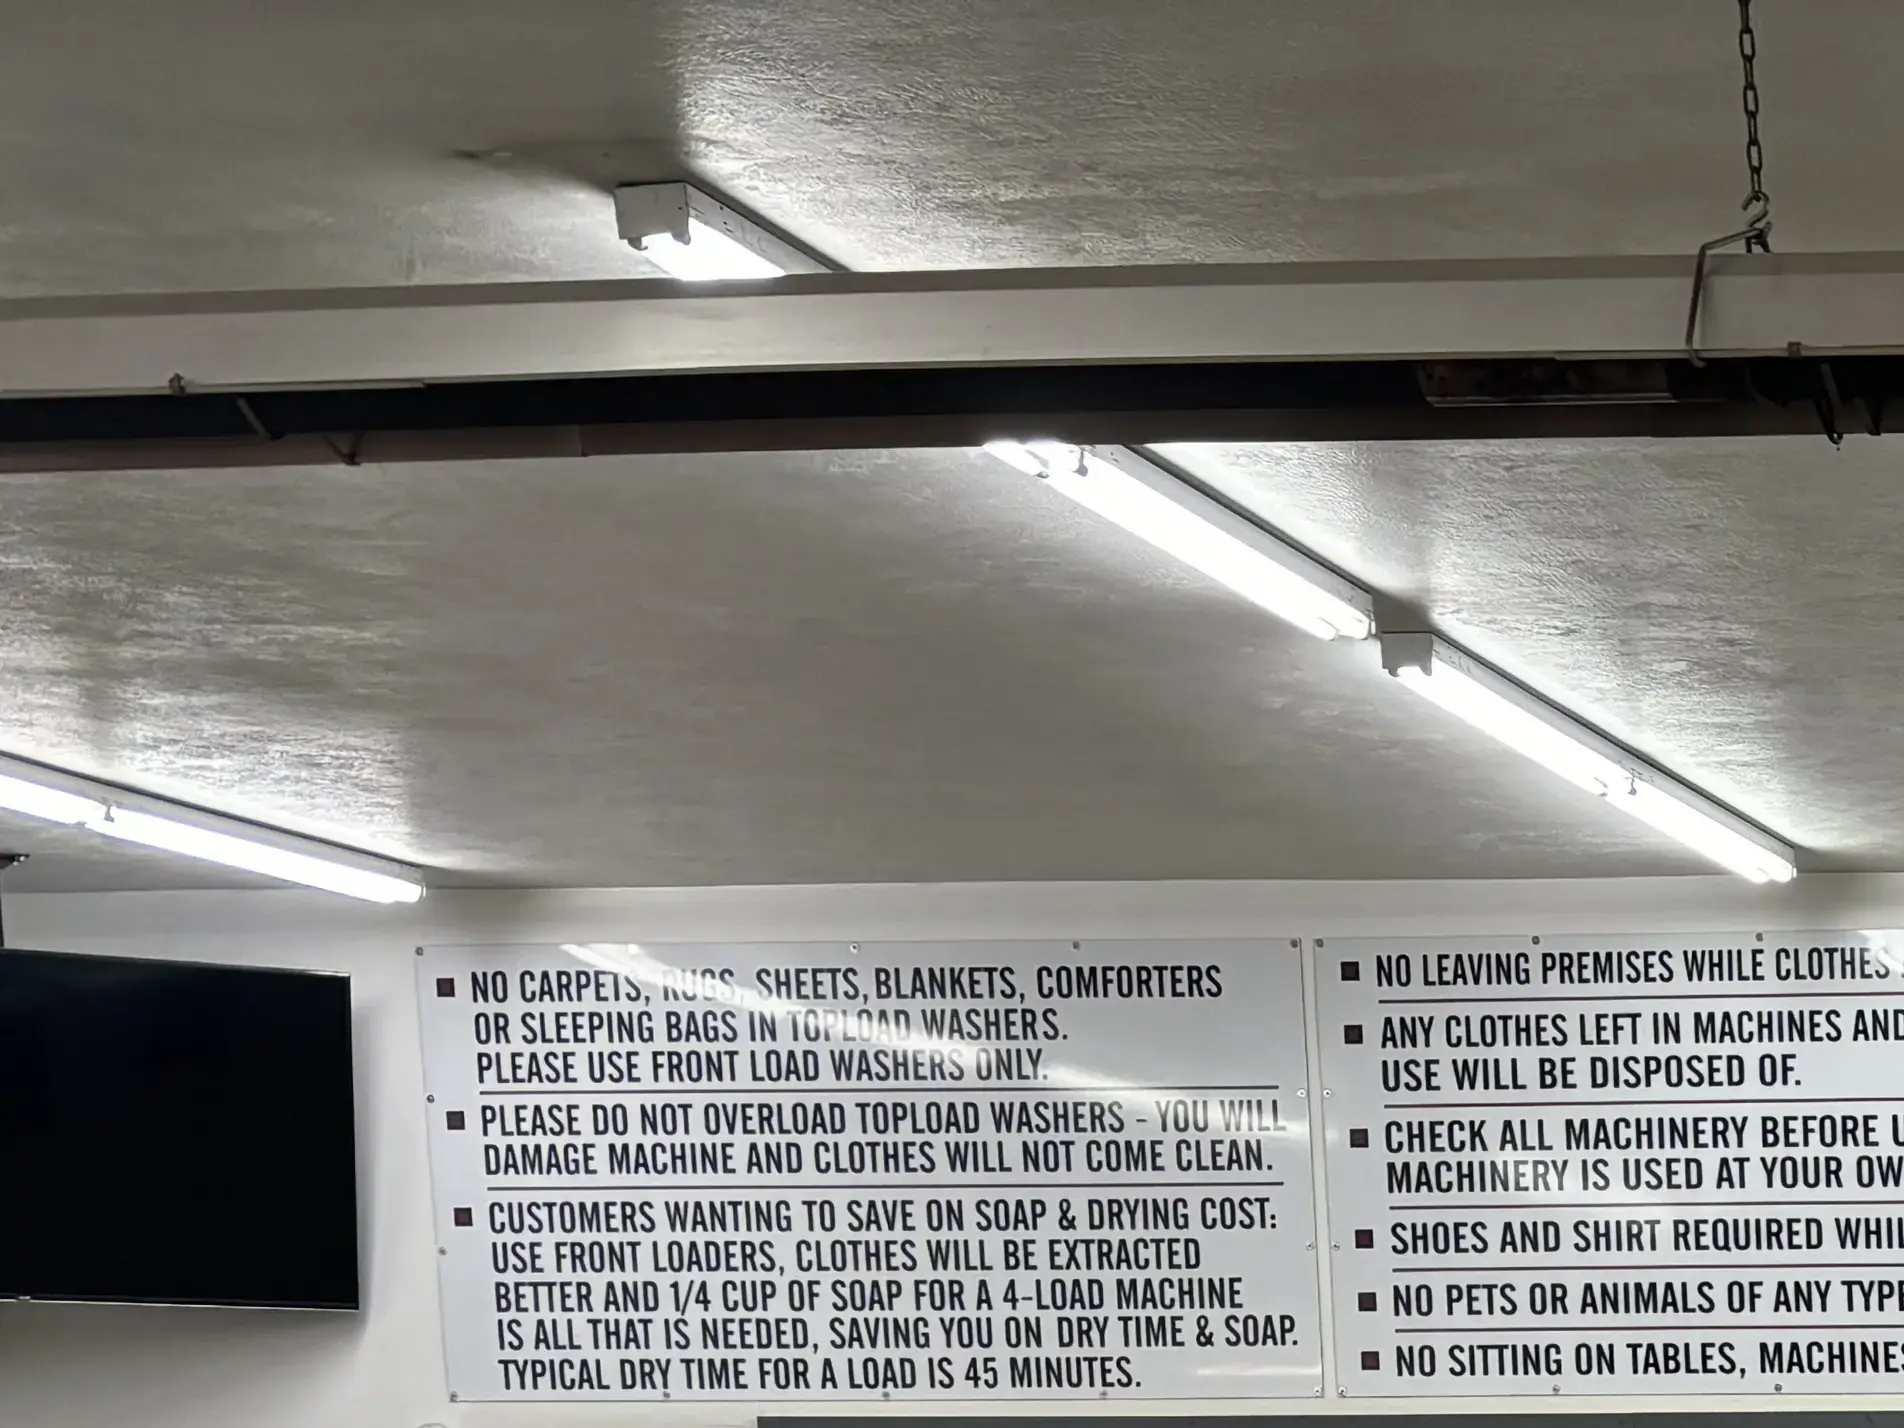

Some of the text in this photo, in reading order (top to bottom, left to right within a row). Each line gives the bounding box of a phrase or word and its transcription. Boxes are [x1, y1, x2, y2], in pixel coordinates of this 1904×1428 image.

[477, 1048, 1047, 1083] PLEASE USE FRONT LOAD WASHERS ONLY.
[1382, 1054, 1801, 1092] USE WILL BE DISPOSED OF.
[1385, 1120, 1488, 1153] CHECK
[1499, 1119, 1553, 1151] ALL
[1565, 1116, 1748, 1150] MACHINERY
[1761, 1115, 1879, 1148] BEFORE
[484, 1139, 1272, 1175] DAMAGE MACHINE AND CLOTHES WILL NOT COME CLEAN.
[1393, 1284, 1433, 1316] NO
[1446, 1283, 1517, 1315] PETS
[1530, 1283, 1568, 1315] OR
[1580, 1281, 1715, 1314] ANIMALS
[1728, 1281, 1763, 1313] OF
[1774, 1280, 1831, 1312] ANY
[498, 1356, 1141, 1390] TYPICAL DRY TIME FOR A LOAD IS 45 MINUTES.
[1396, 1345, 1436, 1377] NO
[1448, 1344, 1562, 1376] SITTING
[1575, 1343, 1615, 1375] ON
[1626, 1342, 1745, 1378] TABLES,
